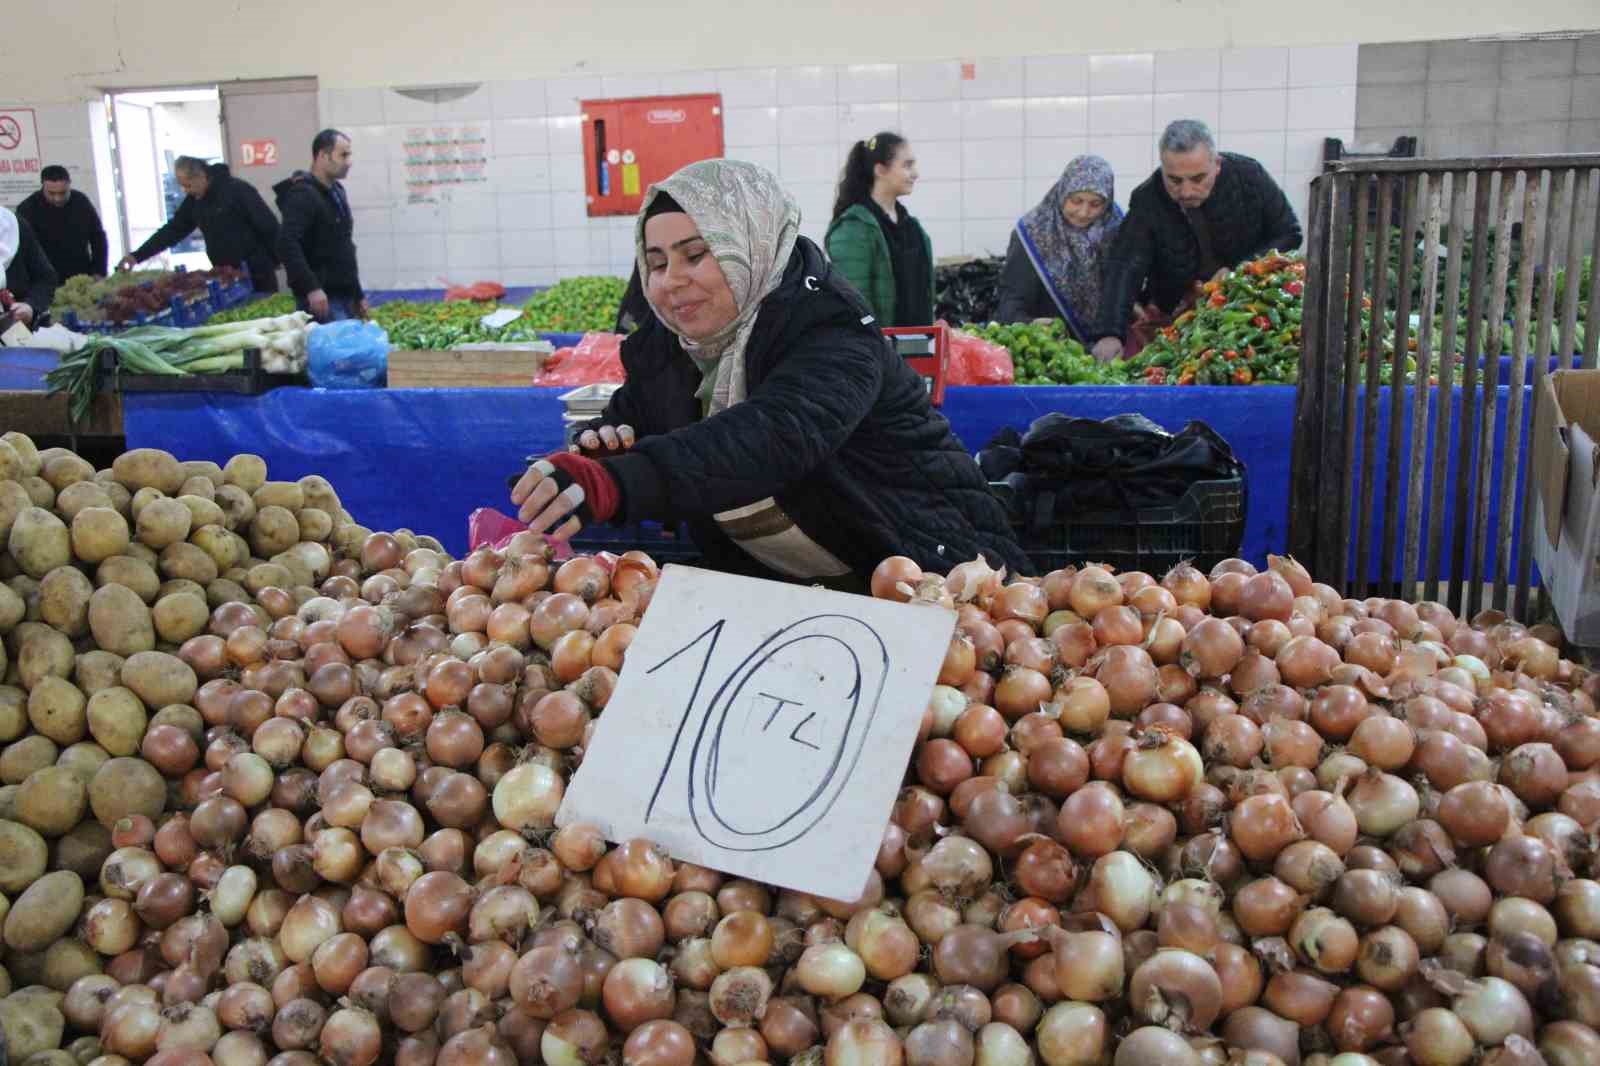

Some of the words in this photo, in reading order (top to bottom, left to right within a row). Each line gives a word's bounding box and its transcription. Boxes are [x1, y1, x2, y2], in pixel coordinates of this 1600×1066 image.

[242, 143, 277, 165] D-2
[644, 613, 890, 851] 10
[758, 691, 821, 750] TL
